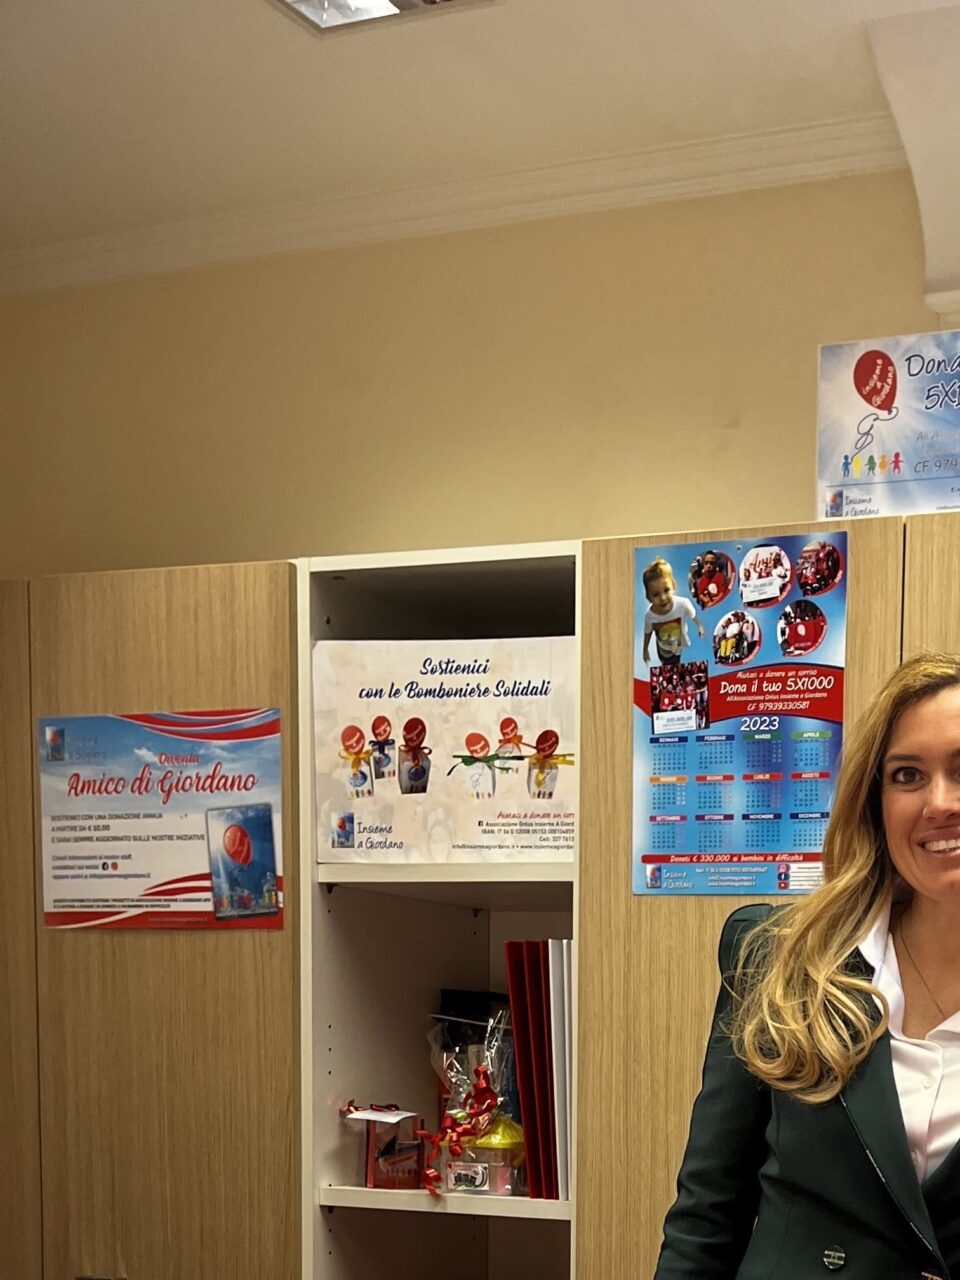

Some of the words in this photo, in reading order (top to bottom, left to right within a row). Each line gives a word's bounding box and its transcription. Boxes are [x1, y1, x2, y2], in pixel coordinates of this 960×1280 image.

[914, 460, 928, 473] CF
[419, 657, 491, 676] Sostienici
[359, 686, 385, 700] con
[388, 682, 403, 699] le
[404, 681, 492, 700] Bomboniere
[493, 680, 552, 698] Solidali
[720, 681, 747, 694] Dona
[751, 680, 758, 693] il
[763, 681, 782, 692] tuo
[786, 676, 834, 691] 5X1000
[758, 701, 810, 711] 97939330581
[740, 716, 779, 731] 2023
[68, 772, 127, 797] Amico
[130, 764, 153, 795] di
[156, 762, 258, 805] Giordano
[357, 821, 393, 835] Insieme
[357, 841, 364, 849] a
[365, 838, 404, 850] Giordano
